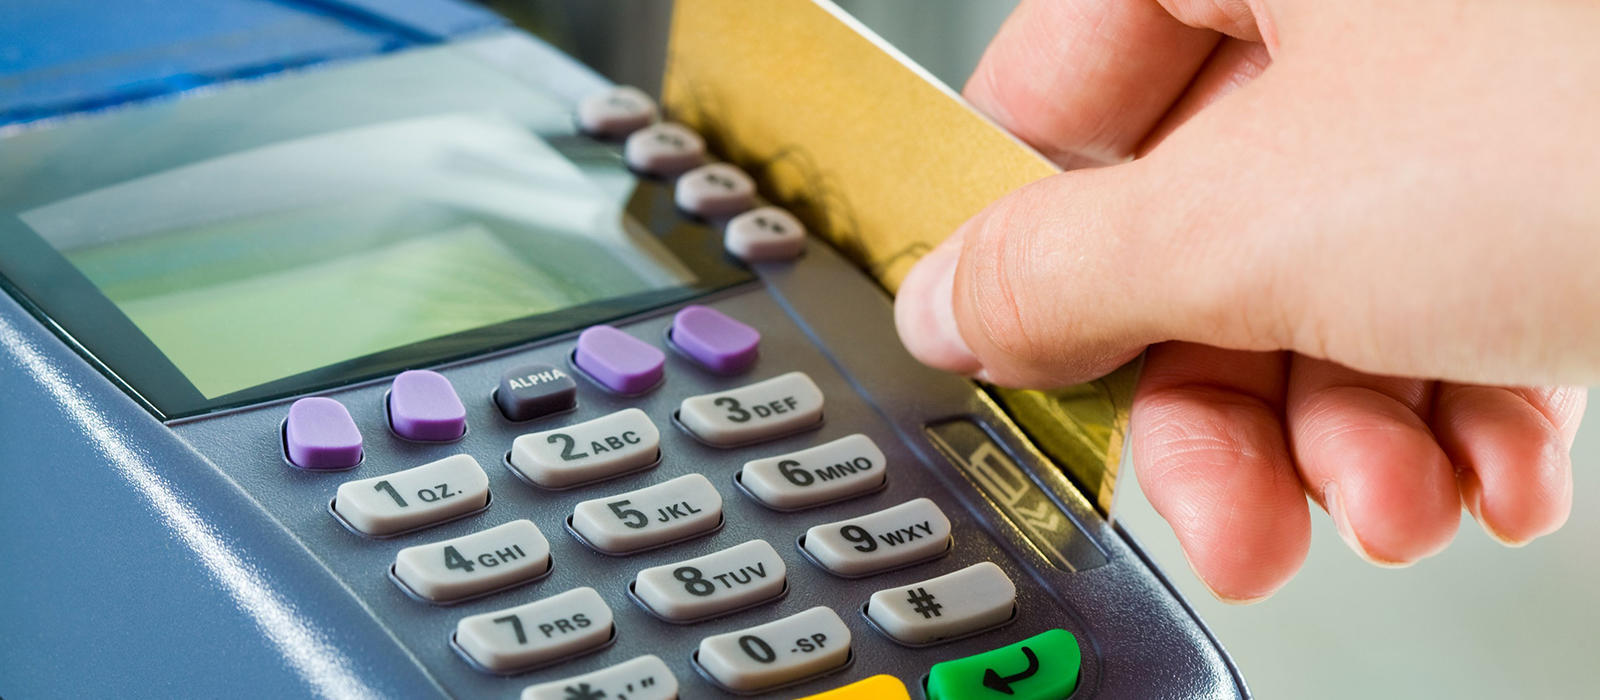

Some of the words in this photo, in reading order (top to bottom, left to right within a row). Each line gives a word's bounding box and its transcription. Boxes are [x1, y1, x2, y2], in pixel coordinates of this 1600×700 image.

[509, 367, 566, 391] ALPHA
[714, 397, 751, 424] 3
[753, 397, 799, 418] DEF
[547, 433, 589, 462] 2
[589, 430, 641, 455] ABC
[777, 459, 815, 487] 6
[817, 456, 873, 482] MNO
[373, 480, 409, 508] 1
[607, 500, 649, 529] 5
[657, 502, 702, 523] JKL
[839, 524, 879, 553] 9
[878, 521, 934, 547] WXY
[444, 545, 475, 573] 4
[477, 544, 526, 568] GHI
[673, 566, 716, 597] 8
[713, 562, 768, 589] TUV
[906, 587, 943, 619] #
[493, 615, 528, 645] 7
[538, 613, 592, 638] PRS
[738, 634, 777, 664] 0
